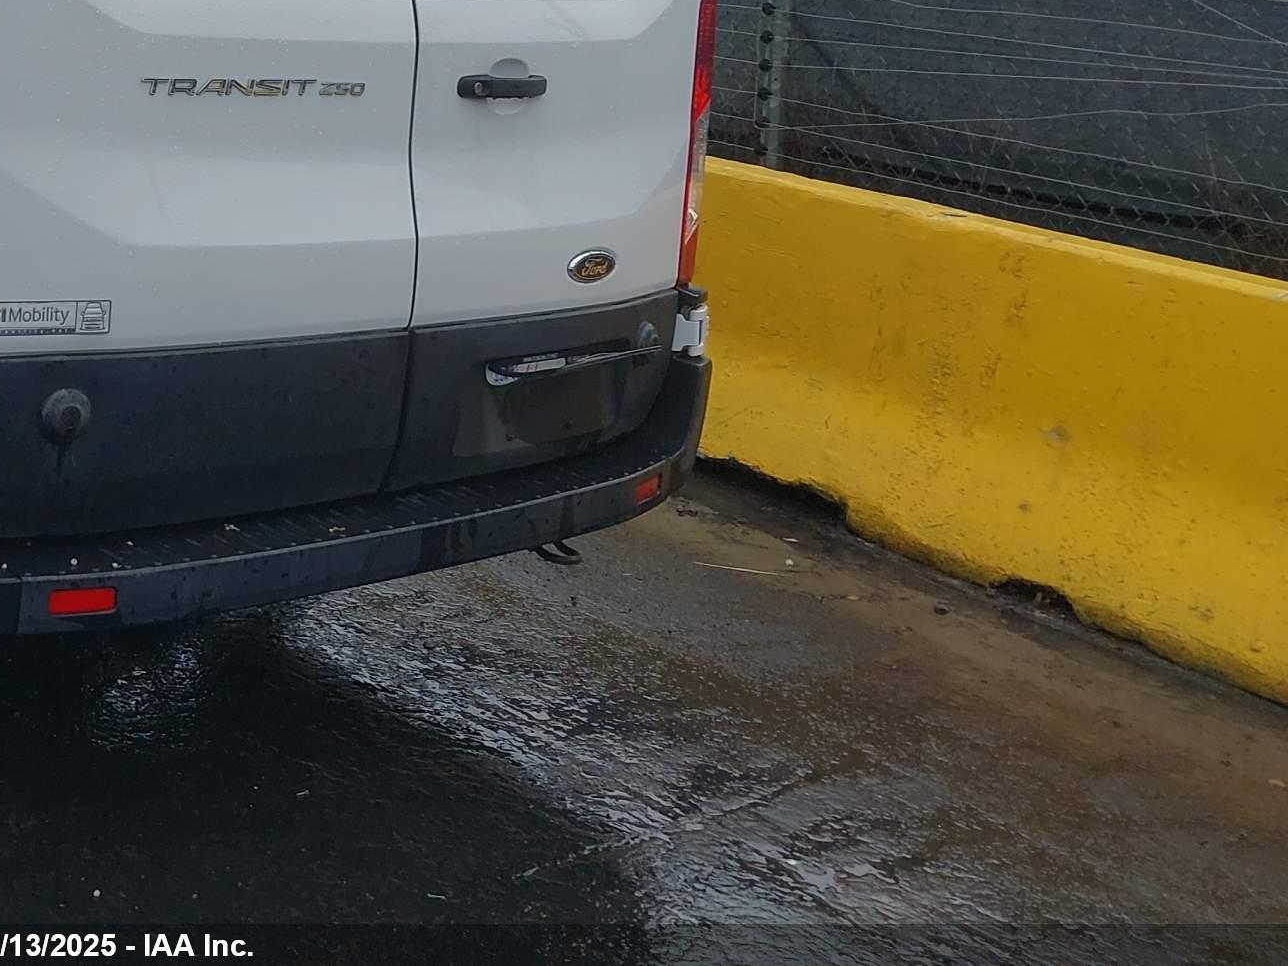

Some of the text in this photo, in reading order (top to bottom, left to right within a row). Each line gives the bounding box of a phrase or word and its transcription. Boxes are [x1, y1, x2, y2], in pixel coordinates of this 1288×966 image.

[140, 78, 366, 97] TRANSIT 250
[8, 306, 70, 326] Mobility
